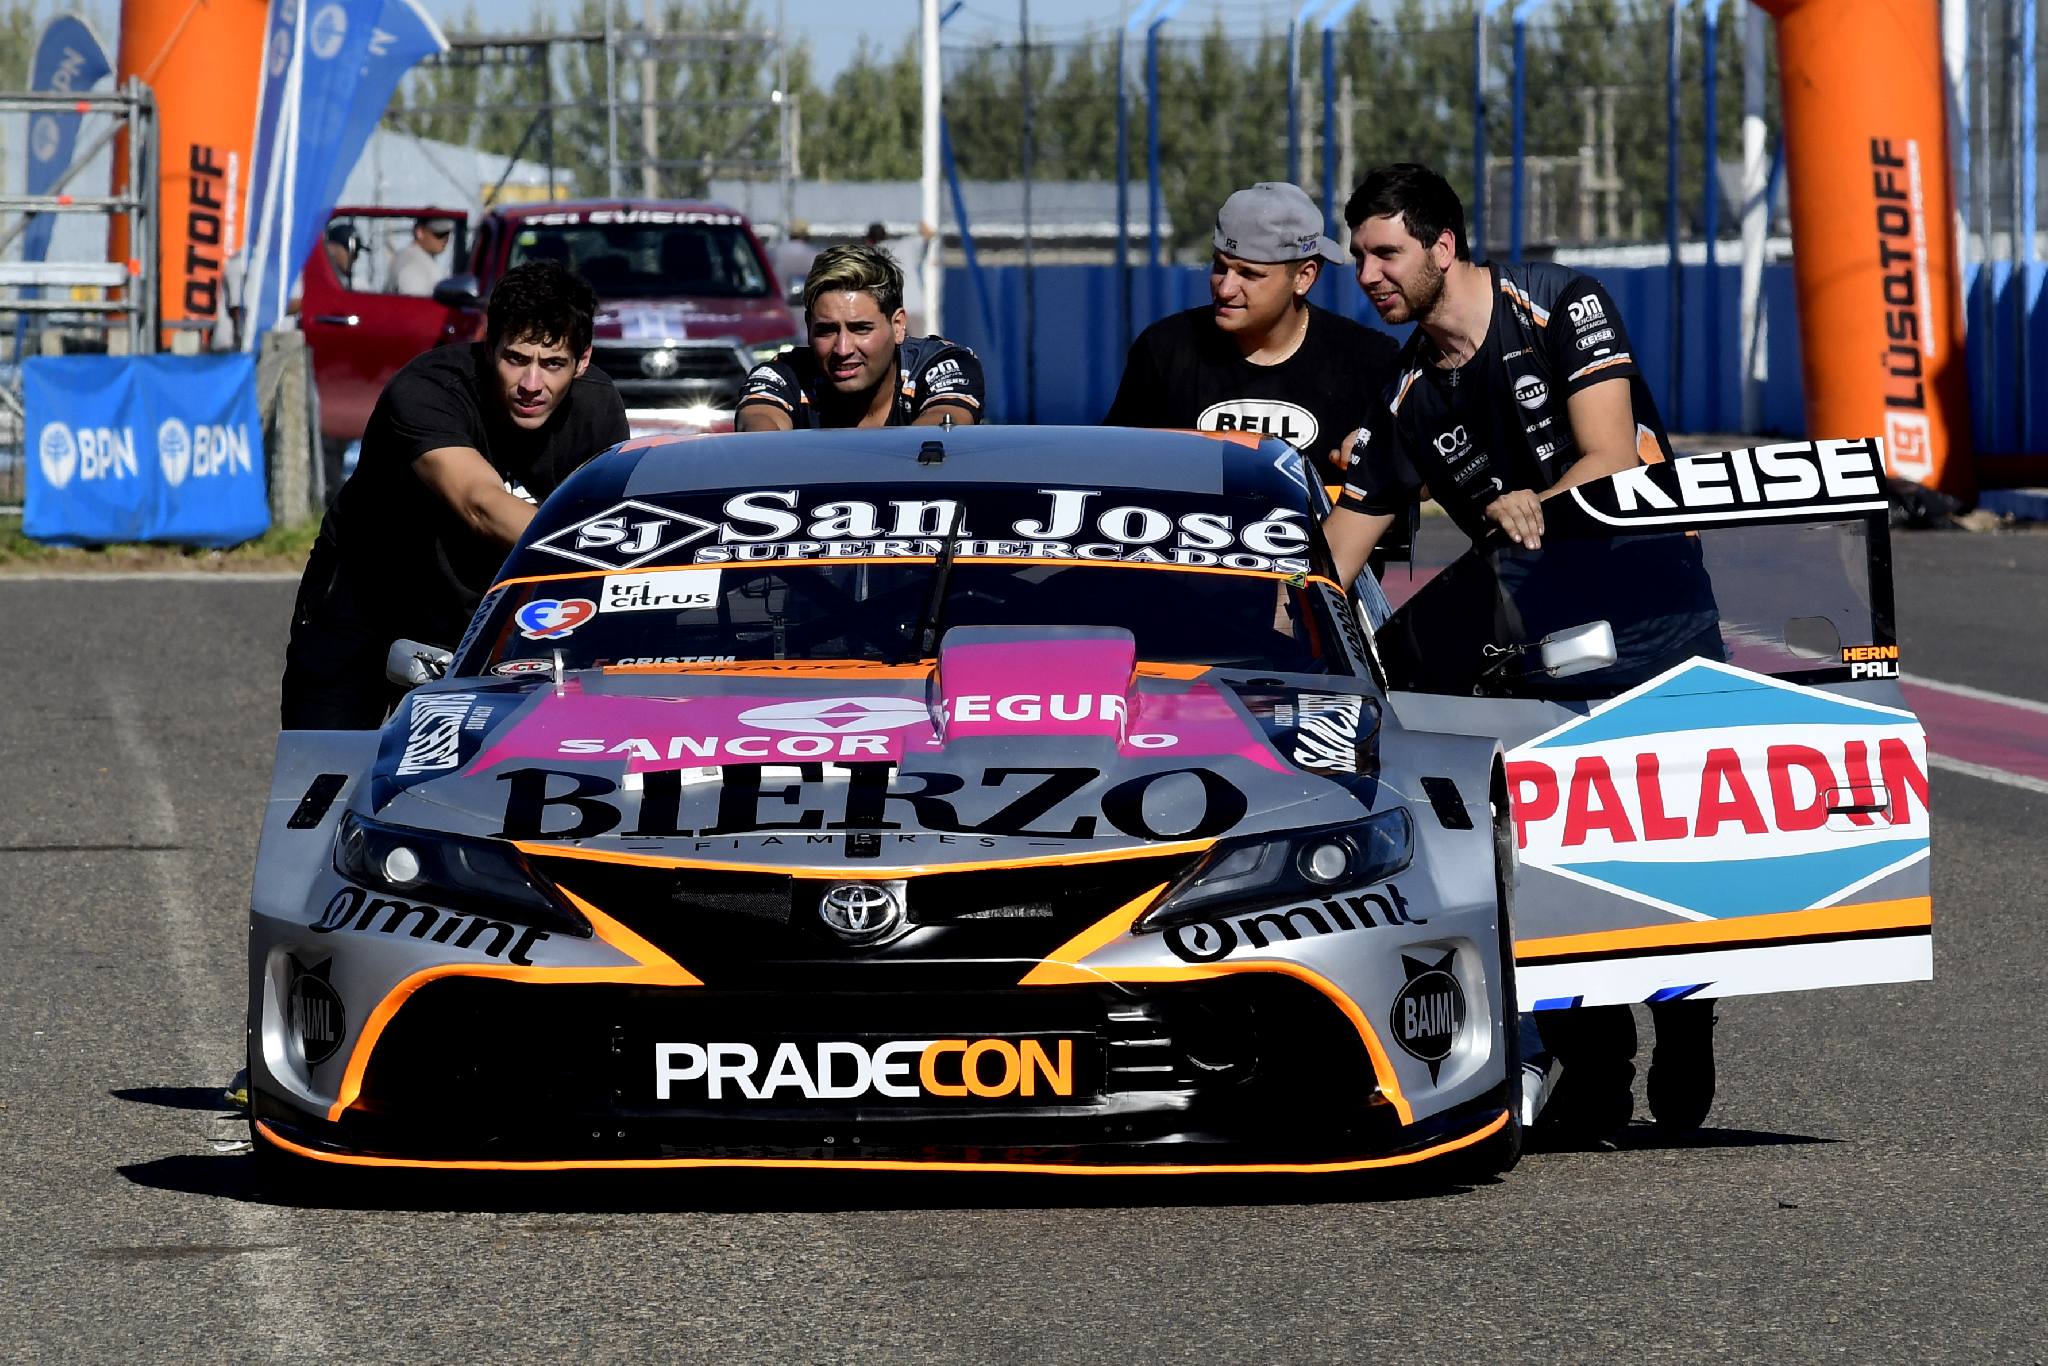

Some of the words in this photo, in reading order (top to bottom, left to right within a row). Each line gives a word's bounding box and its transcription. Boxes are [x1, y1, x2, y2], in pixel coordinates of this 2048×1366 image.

[53, 46, 86, 93] PN
[1580, 330, 1612, 348] KEISER
[1515, 381, 1546, 401] Gulf
[1215, 412, 1299, 438] BELL
[77, 425, 138, 481] BPN
[192, 422, 252, 478] BPN
[1611, 437, 1887, 511] KEISE
[576, 517, 671, 554] SJ
[718, 490, 972, 544] San
[1012, 489, 1309, 554] José
[694, 539, 1311, 574] SUPERMERCADOS
[610, 580, 650, 596] tri
[610, 591, 711, 608] citrus
[1843, 646, 1898, 662] HERN
[1852, 661, 1899, 679] PAL
[557, 735, 890, 761] SANCOR
[486, 761, 1248, 841] BIERZO
[1505, 736, 1930, 849] PALADIN
[695, 832, 996, 849] FIAMRES
[655, 1038, 1073, 1100] PRADECON
